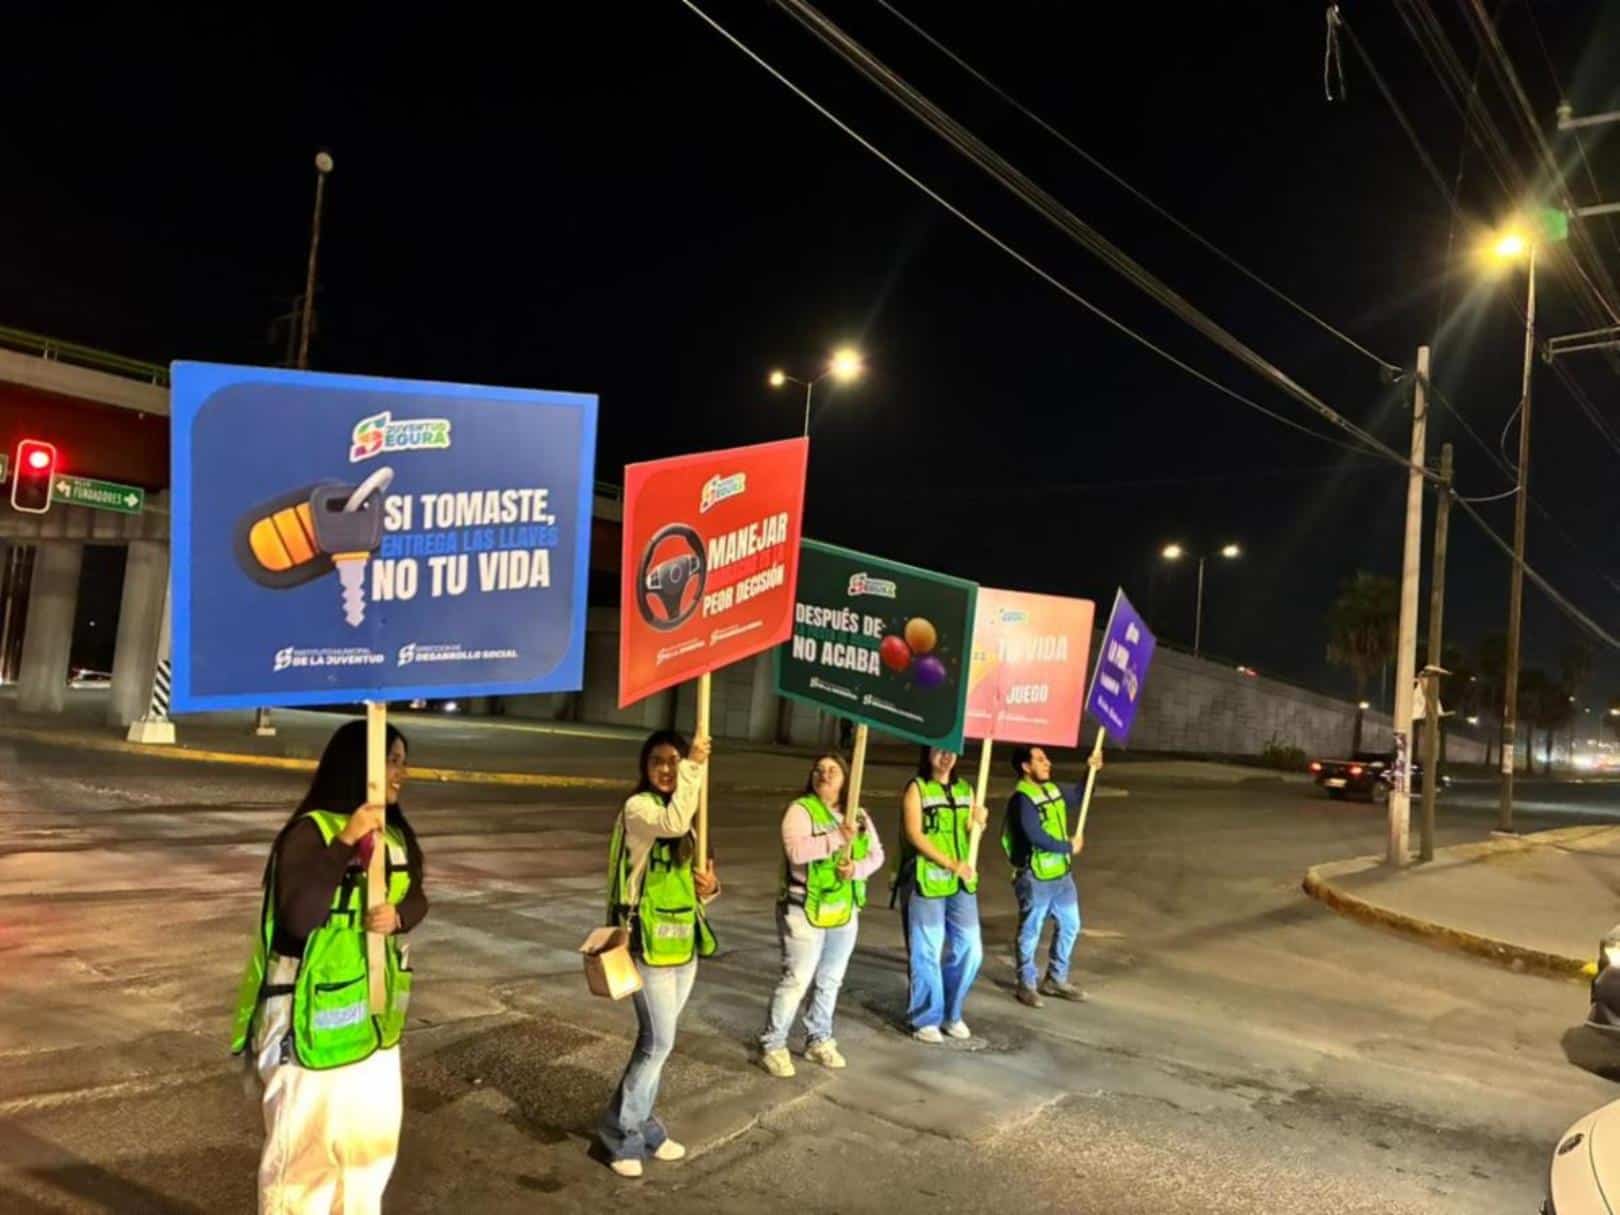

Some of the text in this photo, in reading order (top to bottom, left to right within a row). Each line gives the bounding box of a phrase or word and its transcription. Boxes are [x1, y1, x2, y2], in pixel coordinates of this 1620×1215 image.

[384, 489, 555, 531] SI TOMASTE,
[382, 526, 559, 557] ENTREGA LAS LLAVES
[708, 512, 788, 570] MANEJAR
[372, 549, 550, 601] NO TU VIDA
[703, 591, 733, 618] PEOR
[735, 561, 785, 606] DECISIÓN
[796, 602, 859, 633] DESPUÉS
[863, 615, 883, 639] DE
[293, 653, 384, 666] DE LA JUVENTUD
[792, 634, 816, 662] NO
[821, 640, 881, 677] ACABA
[1006, 683, 1049, 705] JUEGO
